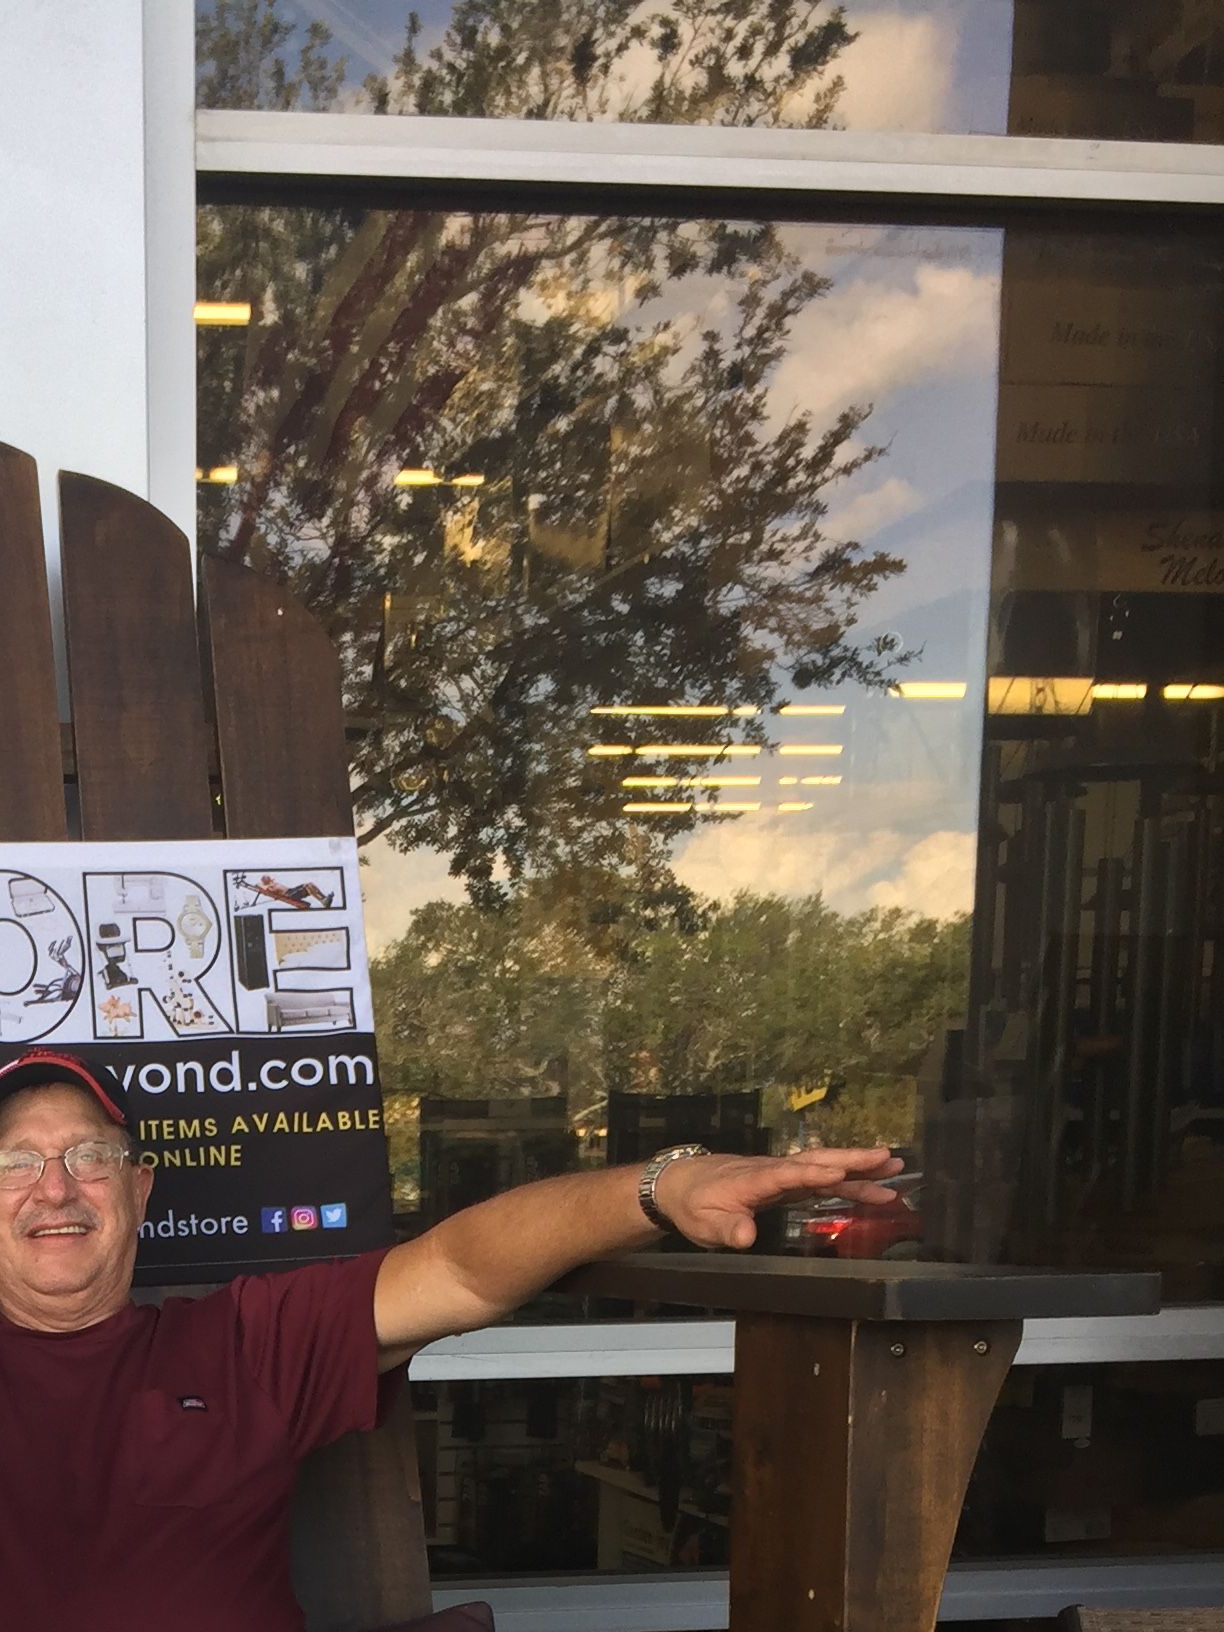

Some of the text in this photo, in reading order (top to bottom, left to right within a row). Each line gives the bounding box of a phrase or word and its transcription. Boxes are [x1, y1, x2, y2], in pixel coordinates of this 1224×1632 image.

[138, 1118, 218, 1141] ITEMS
[231, 1108, 381, 1134] AVAILABLE
[139, 1144, 243, 1169] ONLINE
